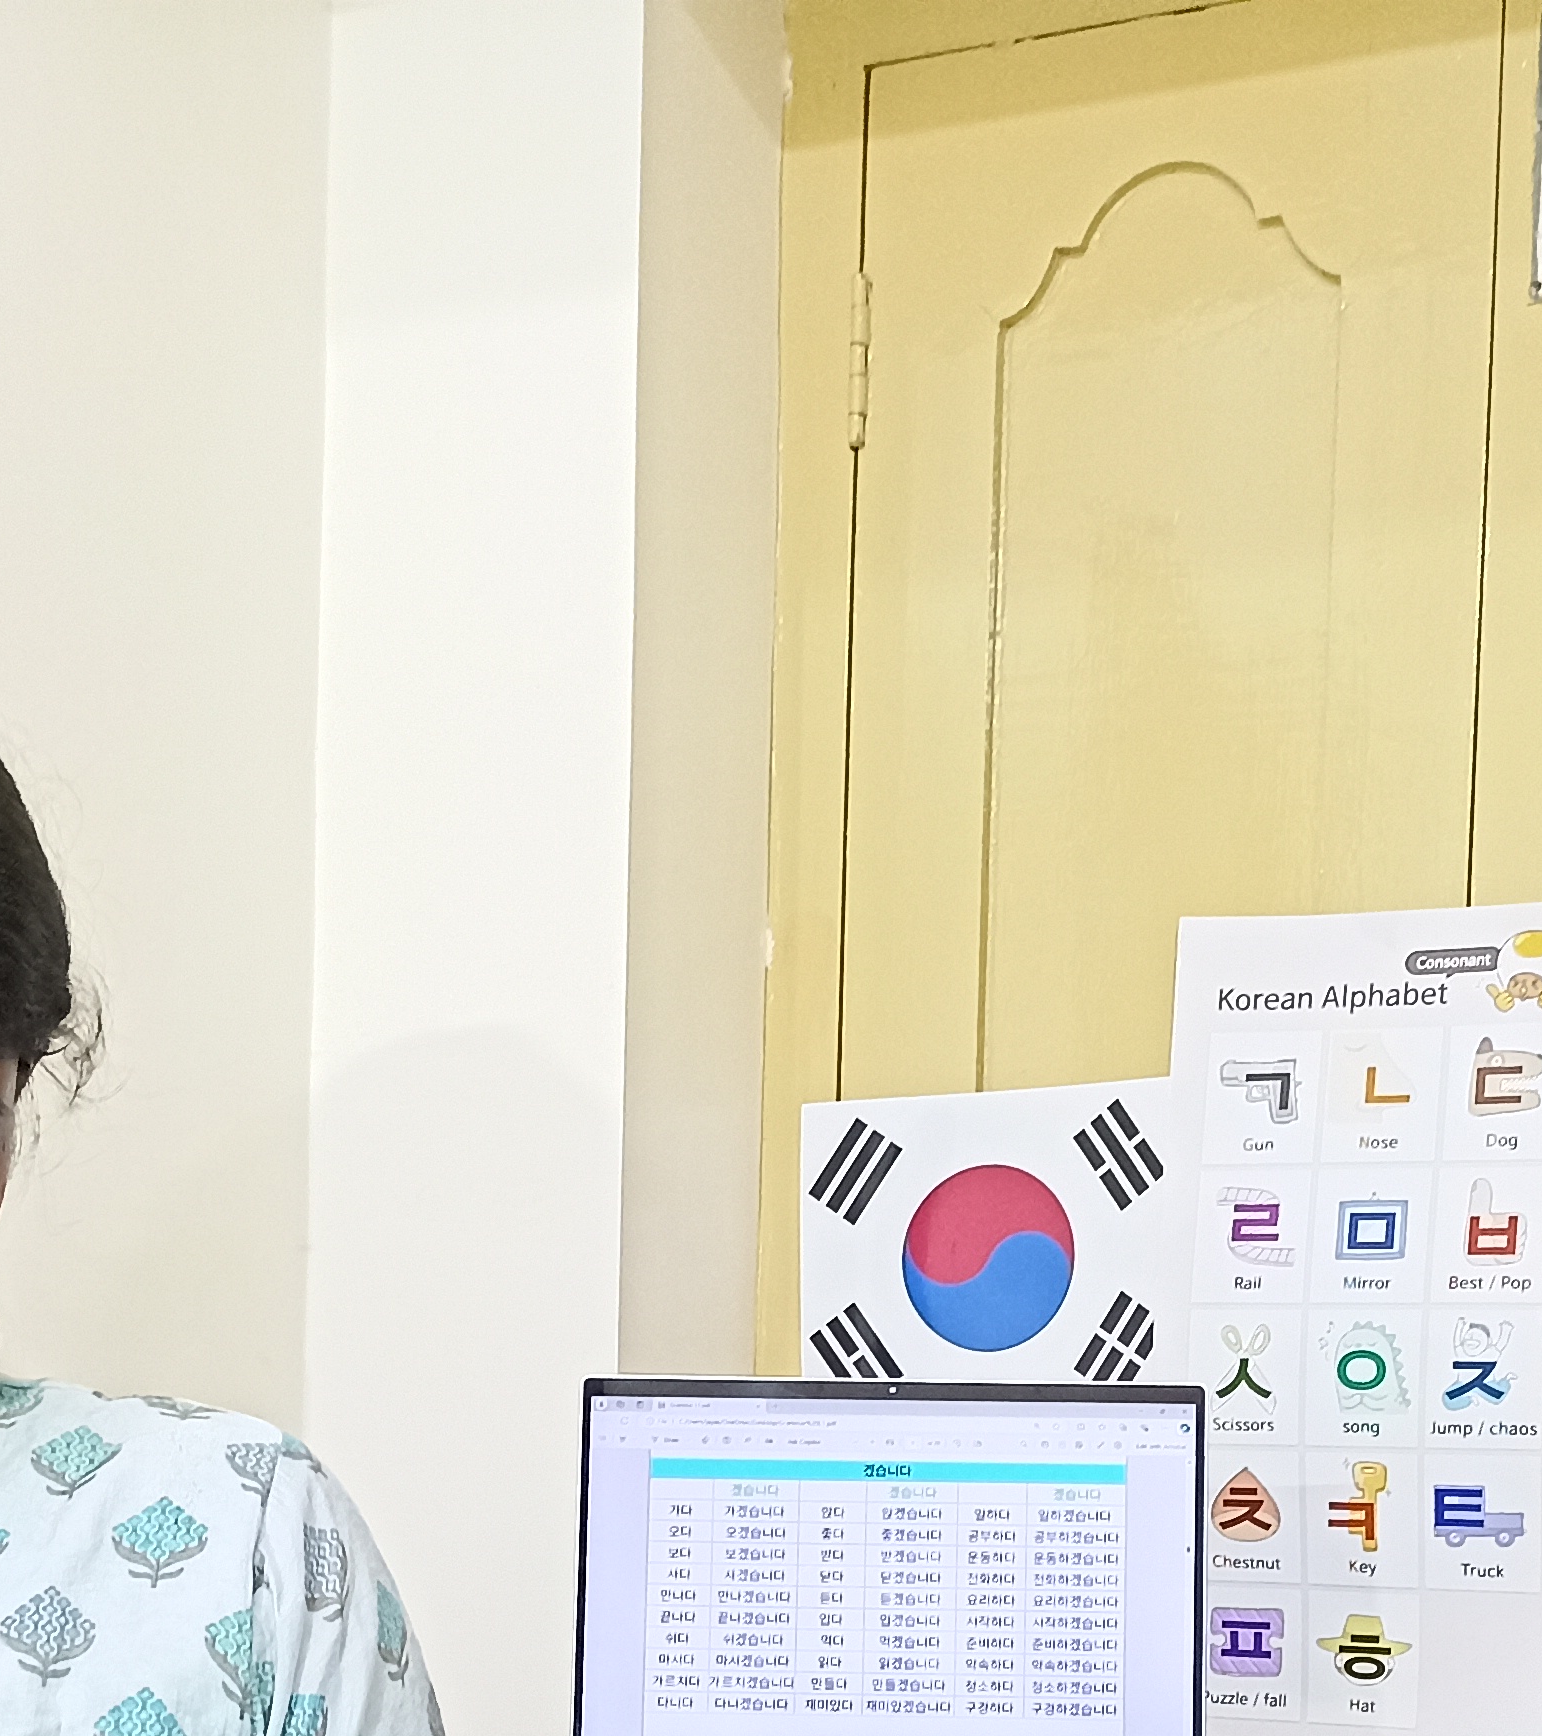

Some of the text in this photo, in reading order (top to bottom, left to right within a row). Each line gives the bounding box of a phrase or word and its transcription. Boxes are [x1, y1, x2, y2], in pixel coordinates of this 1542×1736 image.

[1415, 951, 1492, 970] Consonant
[1217, 983, 1449, 1014] Korean Alphabet
[1242, 1137, 1274, 1152] Gun
[1359, 1135, 1398, 1150] Nose
[1485, 1133, 1518, 1150] Dog
[1234, 1276, 1262, 1290] Rail
[1343, 1275, 1391, 1290] Mirror
[1448, 1275, 1532, 1293] Best / Pop
[1212, 1417, 1275, 1432] Scissors
[1342, 1421, 1380, 1438] song
[1430, 1421, 1538, 1439] Jump / chaos
[1212, 1554, 1281, 1571] Chestnut
[1348, 1560, 1377, 1577] Key
[1460, 1563, 1504, 1579] Truck
[1252, 1691, 1260, 1707] /
[1263, 1692, 1287, 1707] fall
[1349, 1699, 1376, 1713] Hat
